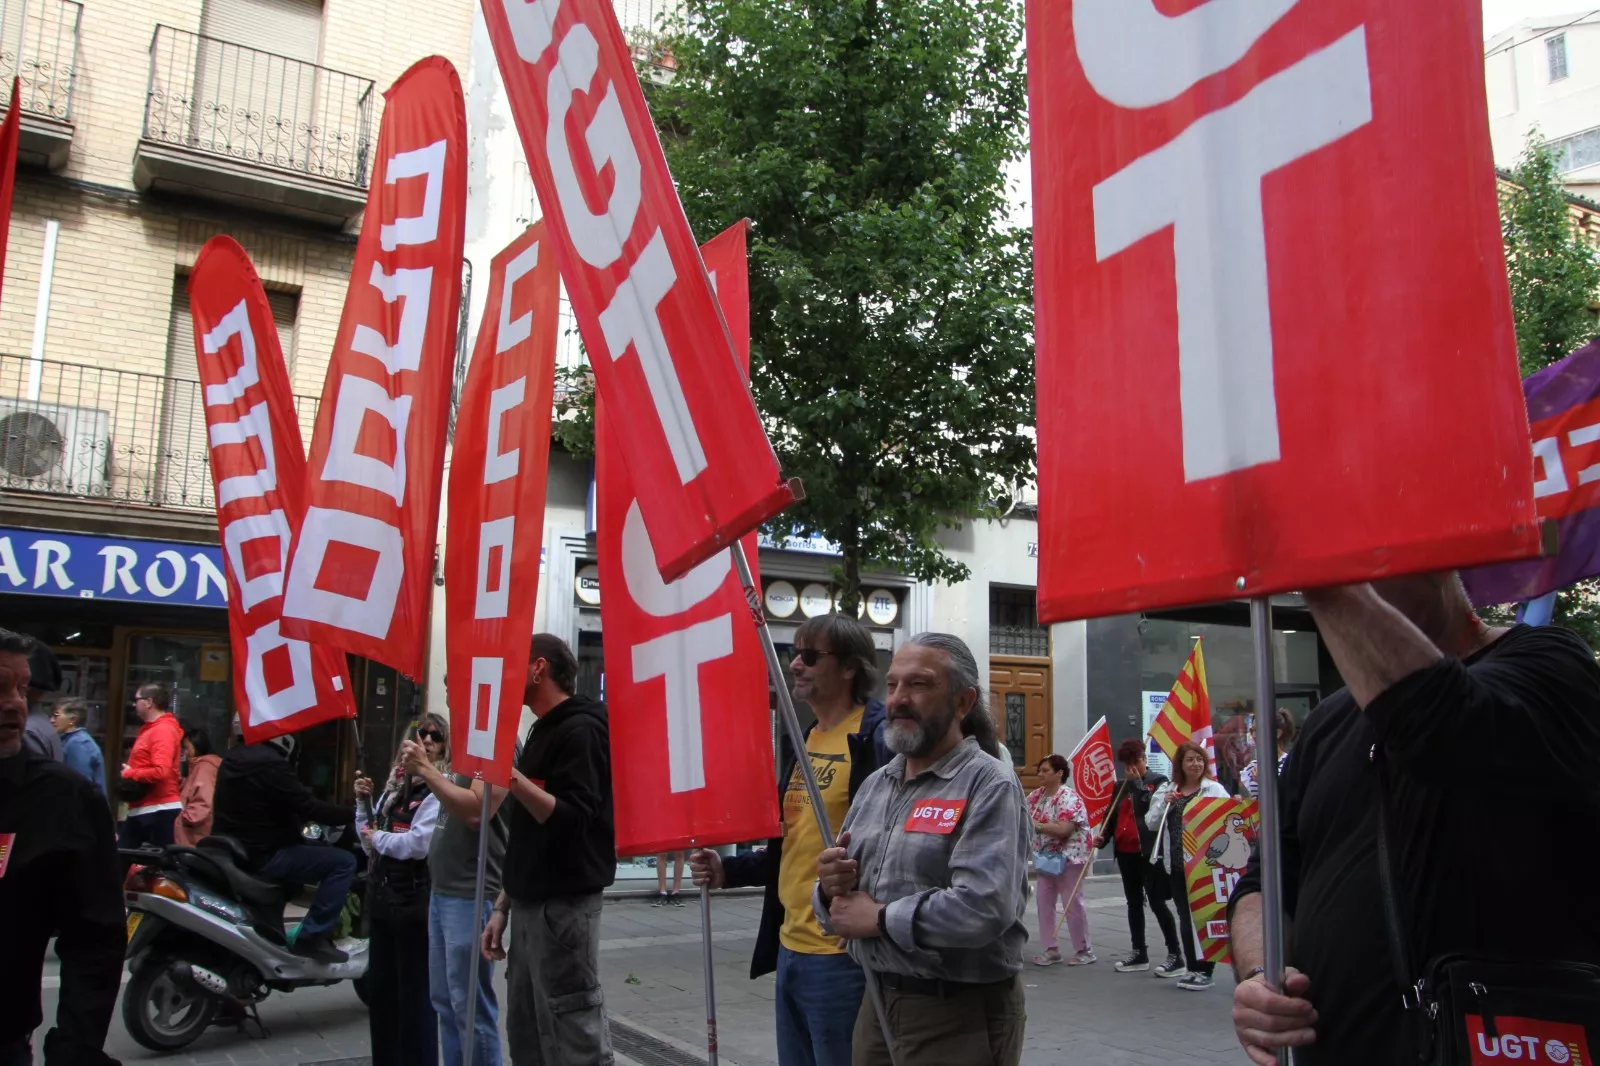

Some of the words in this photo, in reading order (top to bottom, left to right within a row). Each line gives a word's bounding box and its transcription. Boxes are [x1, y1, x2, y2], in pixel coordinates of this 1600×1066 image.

[466, 240, 539, 761] CCOO
[761, 536, 817, 549] Acsorios
[874, 596, 890, 610] ZTE
[913, 806, 943, 820] UGT
[1477, 1032, 1539, 1061] UGT
